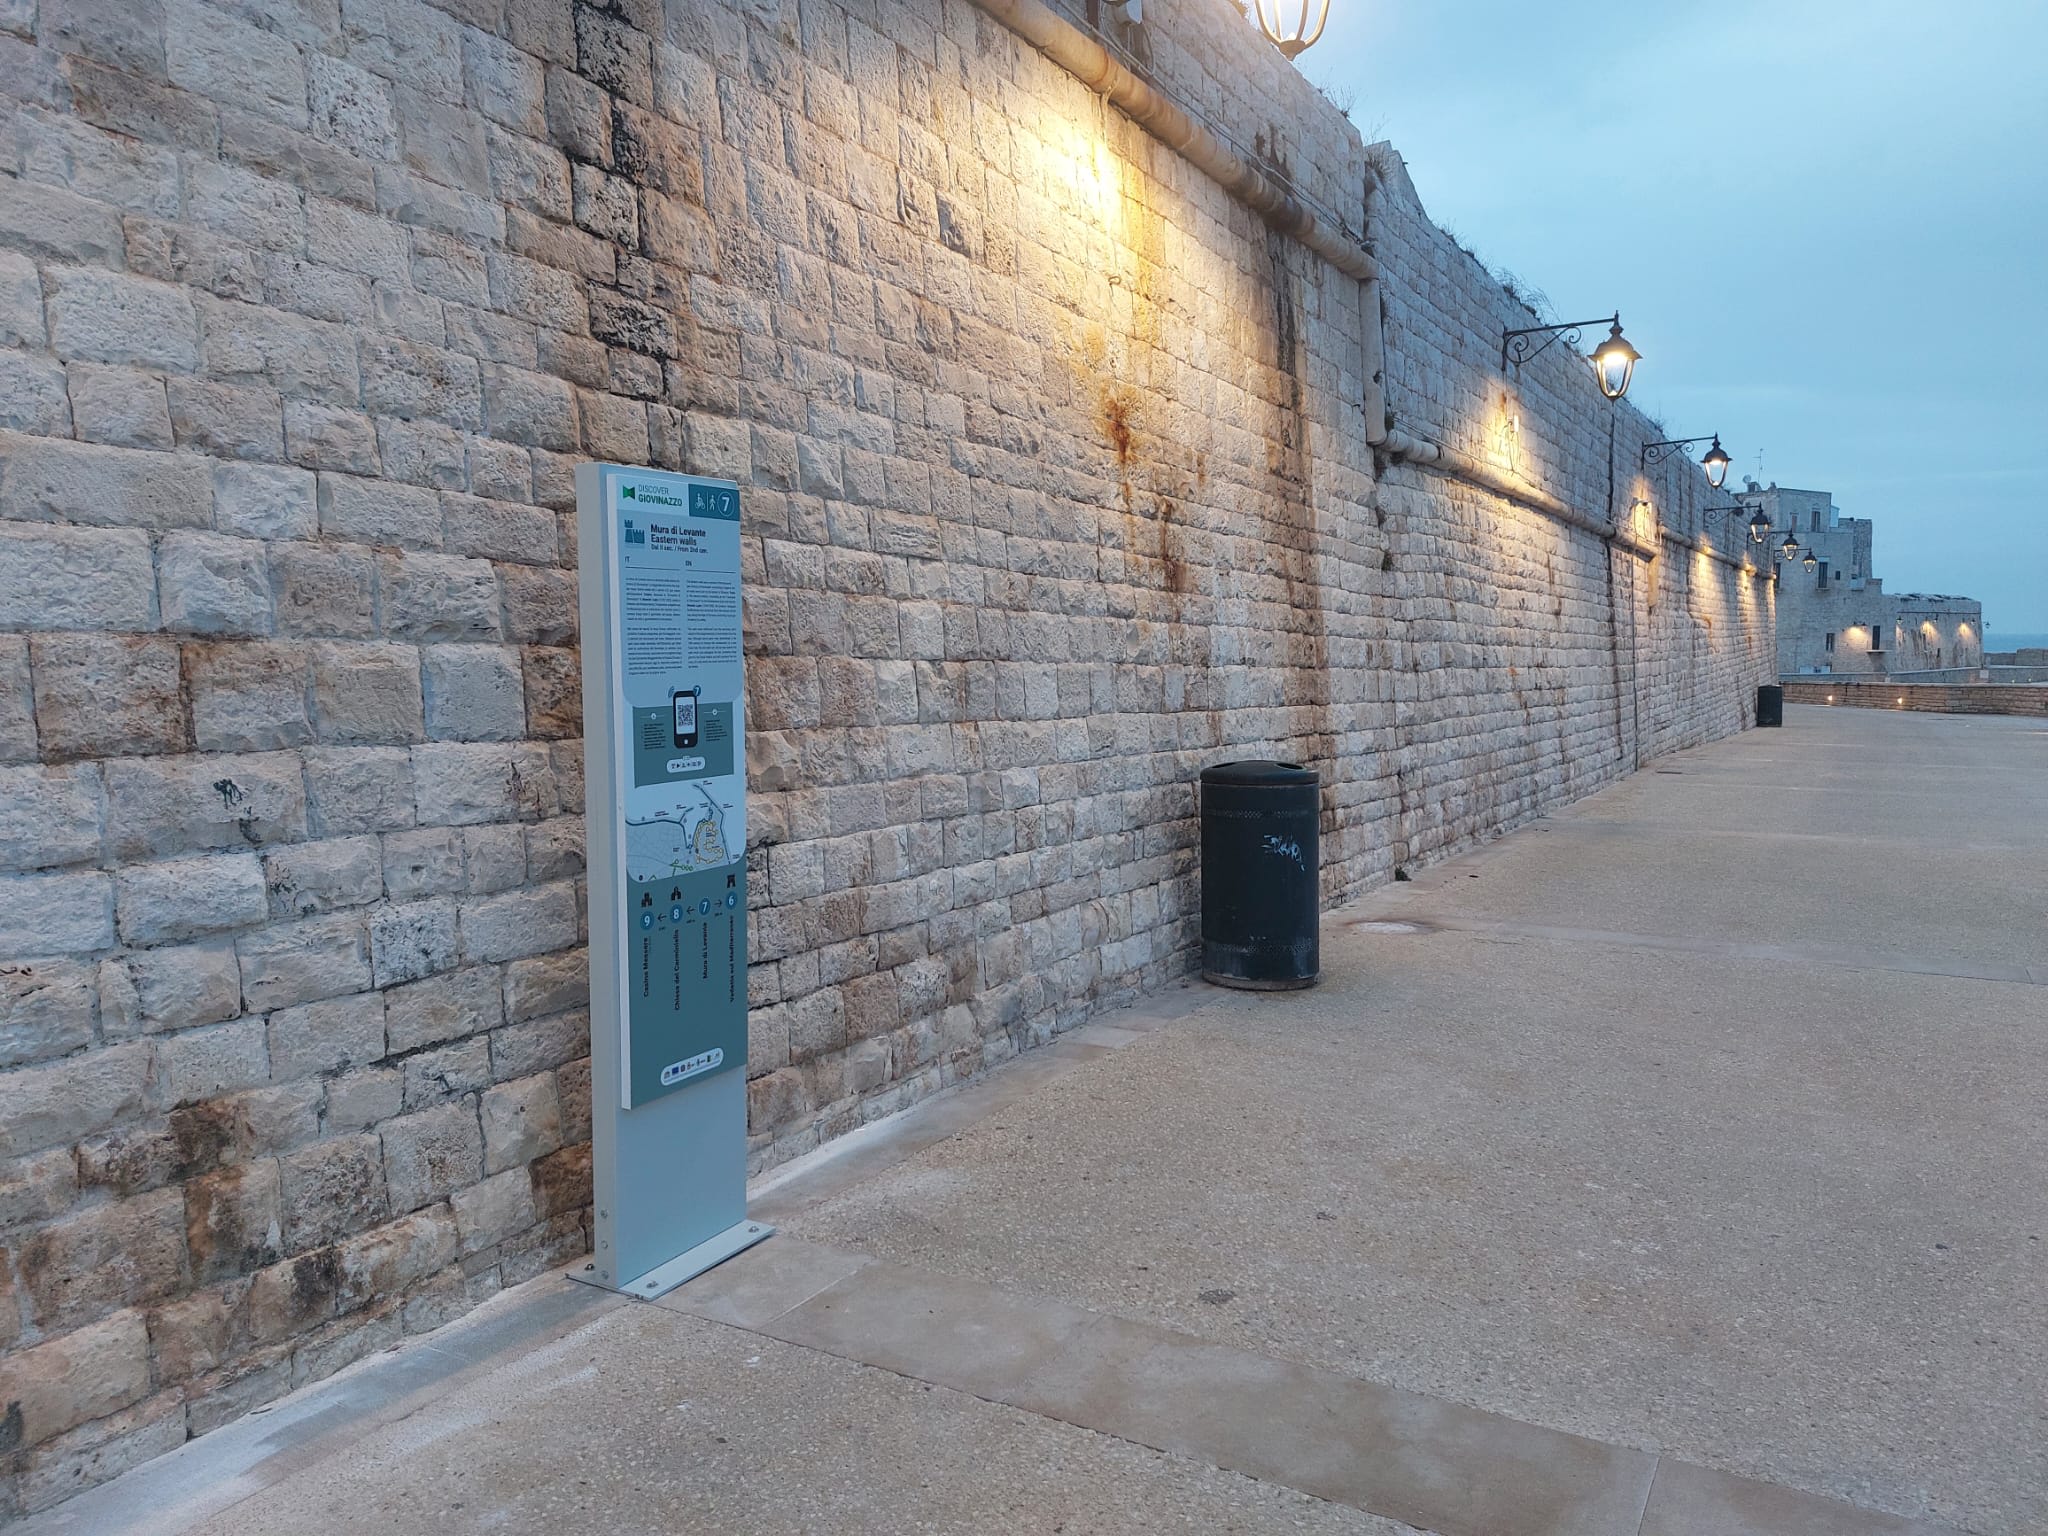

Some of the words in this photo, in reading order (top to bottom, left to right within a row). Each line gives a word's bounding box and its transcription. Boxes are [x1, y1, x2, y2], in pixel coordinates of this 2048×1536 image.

[638, 484, 669, 495] DISCOVER
[638, 494, 682, 506] GIOVINAZZO
[722, 497, 730, 512] 7
[651, 523, 669, 534] Mura
[670, 525, 677, 535] di
[679, 527, 706, 538] Levante
[651, 534, 678, 545] Eastern
[679, 537, 697, 546] walls
[702, 901, 708, 913] 7
[728, 896, 734, 906] 6
[673, 908, 680, 920] 8
[644, 915, 650, 927] 9
